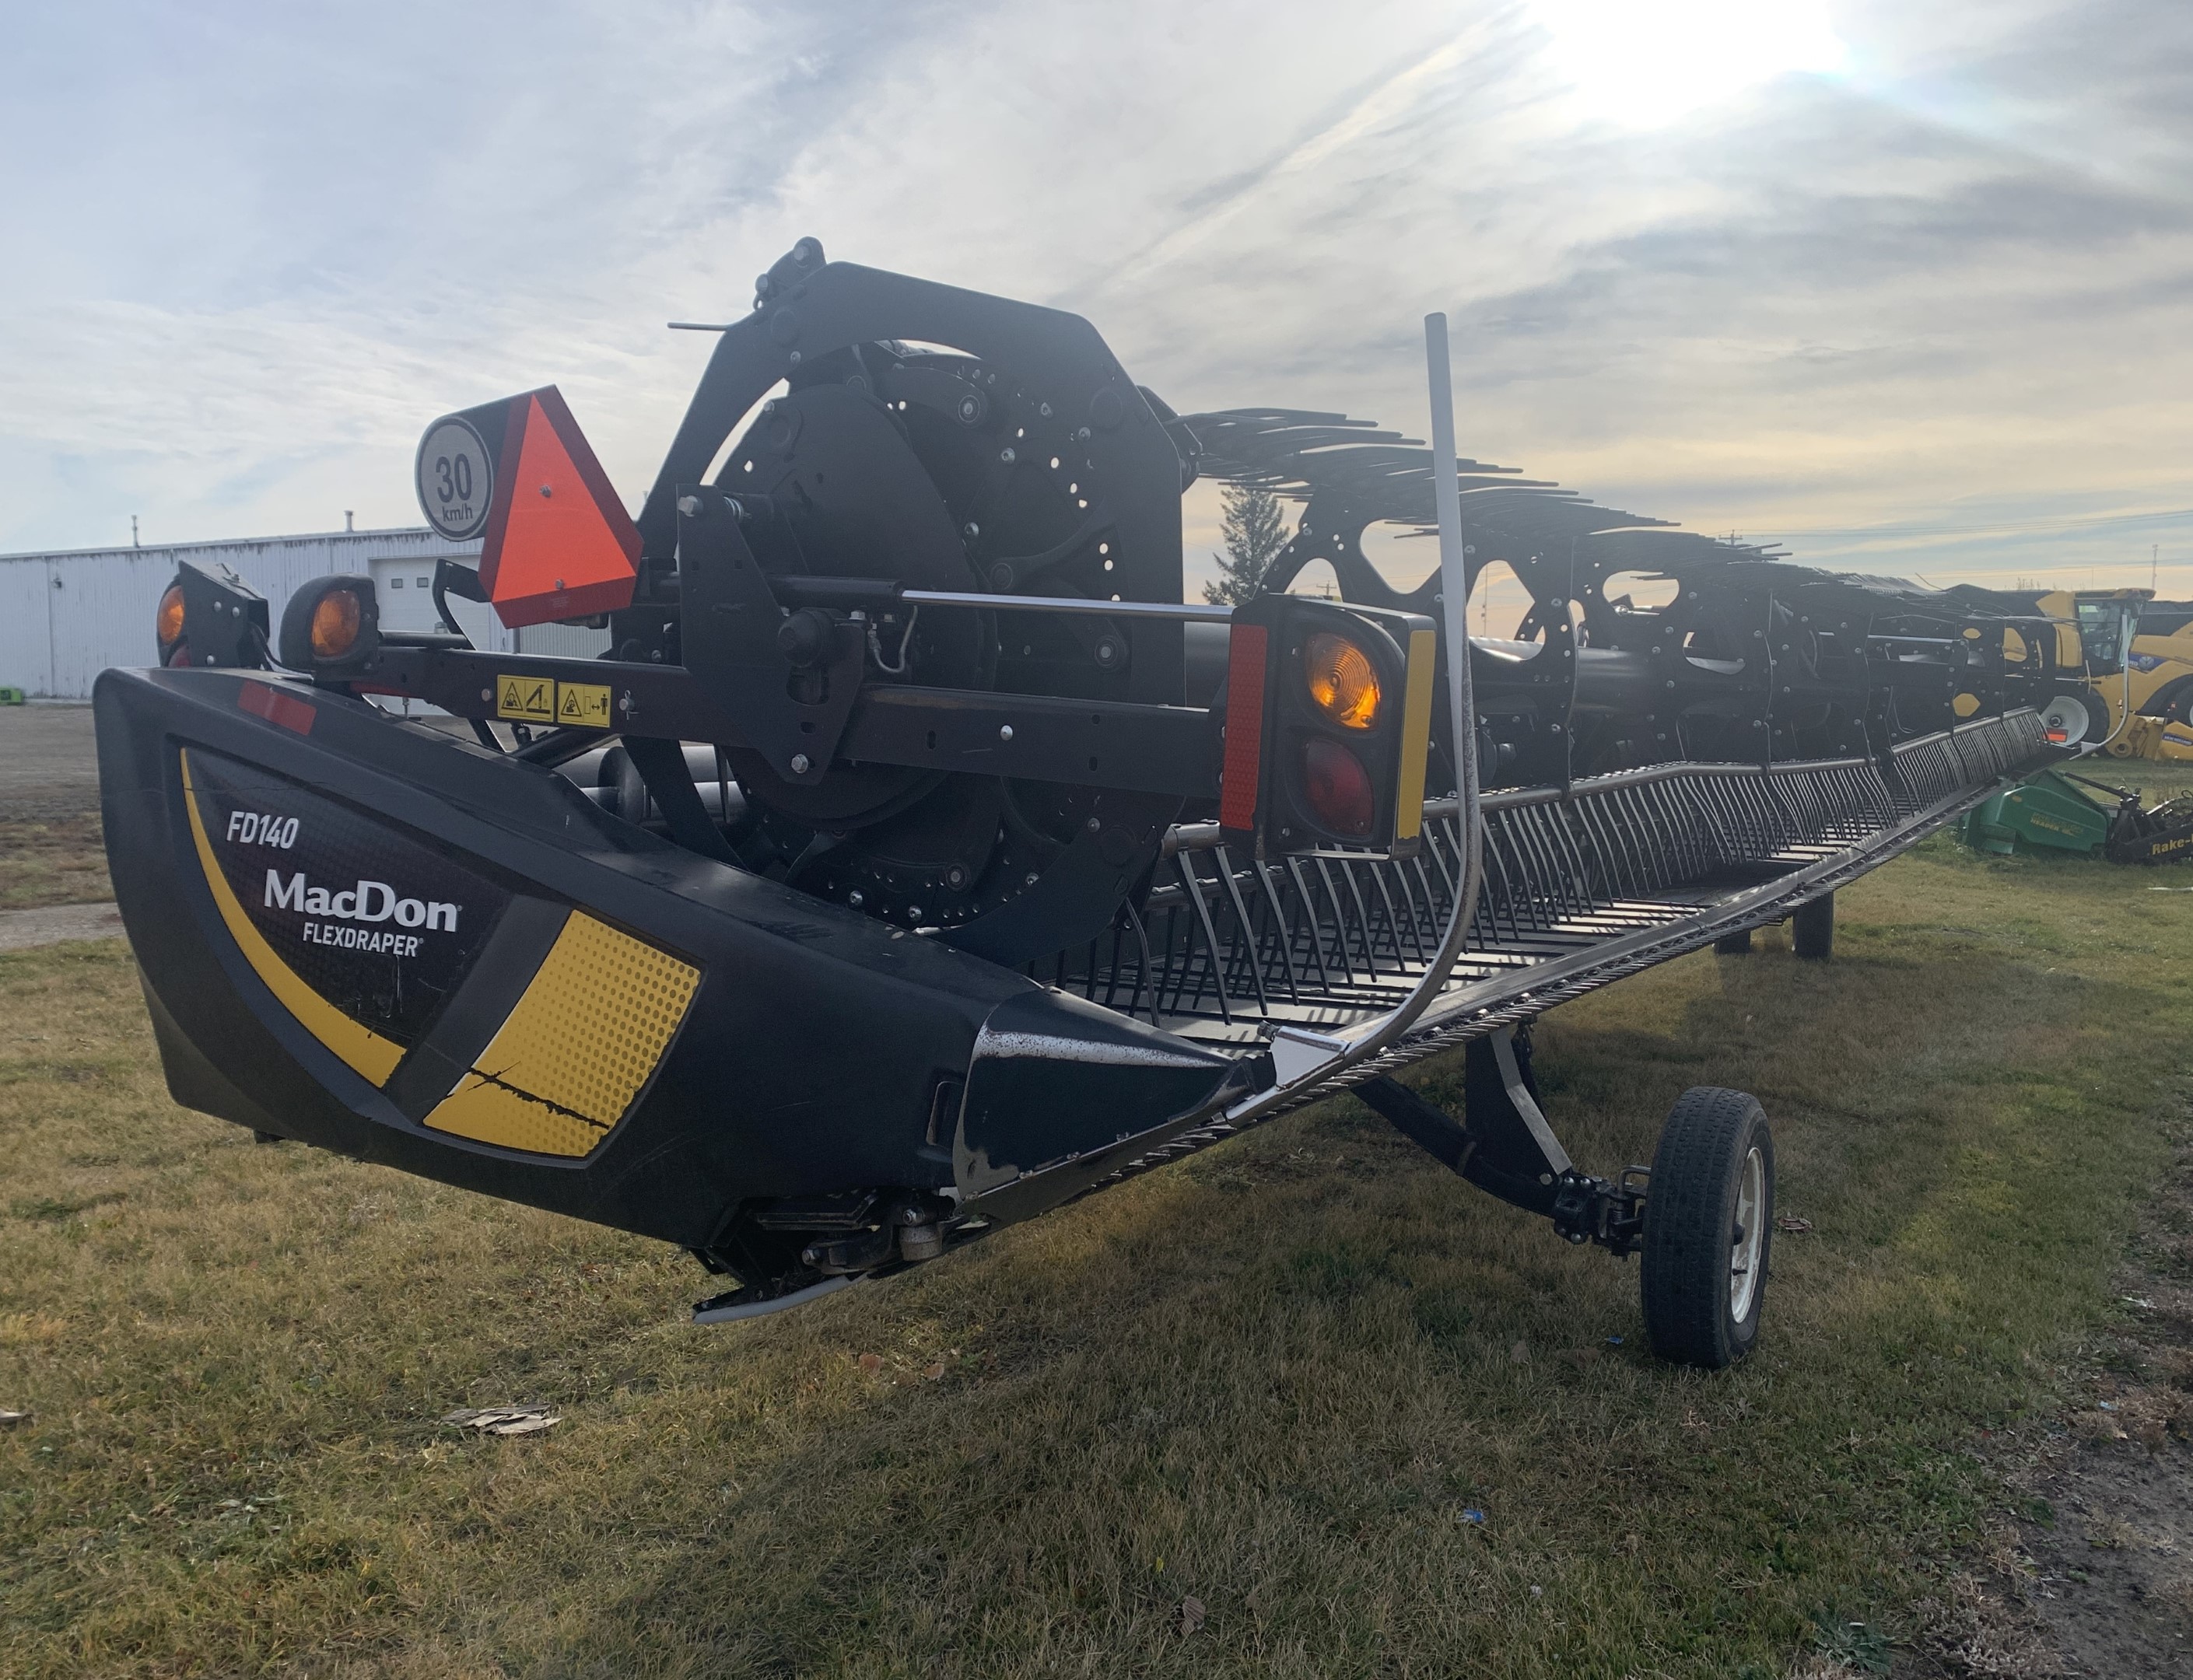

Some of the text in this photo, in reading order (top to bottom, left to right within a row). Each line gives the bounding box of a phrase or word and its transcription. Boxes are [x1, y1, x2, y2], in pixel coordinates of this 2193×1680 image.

[436, 453, 472, 503] 30
[442, 503, 473, 522] km/h
[226, 810, 300, 849] FD140
[2153, 833, 2193, 855] Rake-
